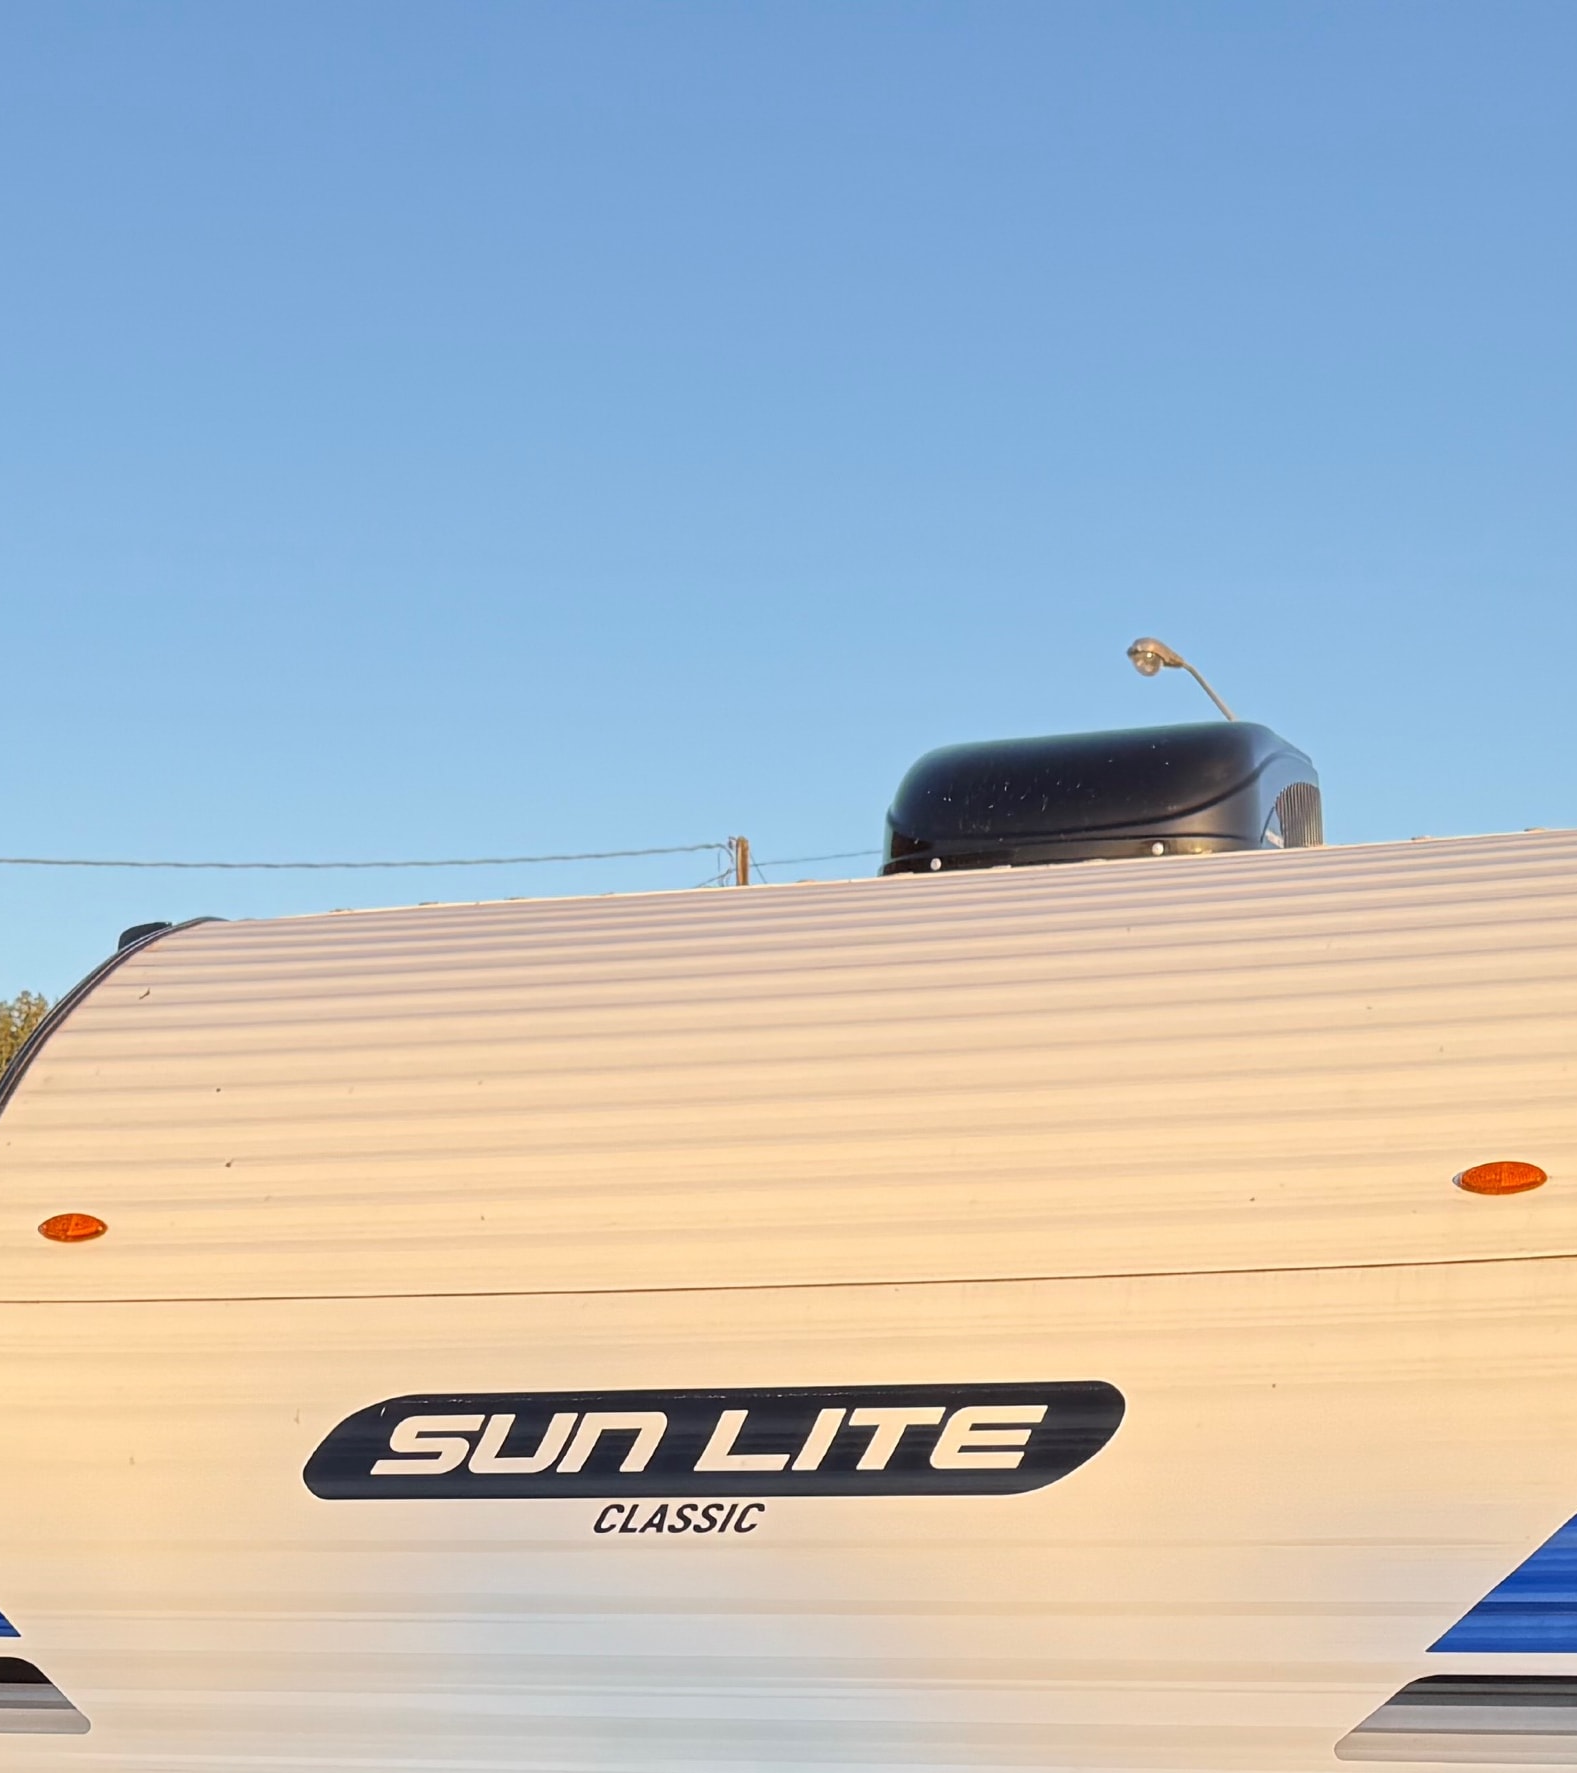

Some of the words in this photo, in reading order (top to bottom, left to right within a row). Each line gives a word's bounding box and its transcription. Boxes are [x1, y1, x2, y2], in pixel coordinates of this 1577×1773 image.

[369, 1412, 668, 1476] SUN
[693, 1404, 1049, 1473] LITE
[592, 1502, 766, 1535] CLASSIC
